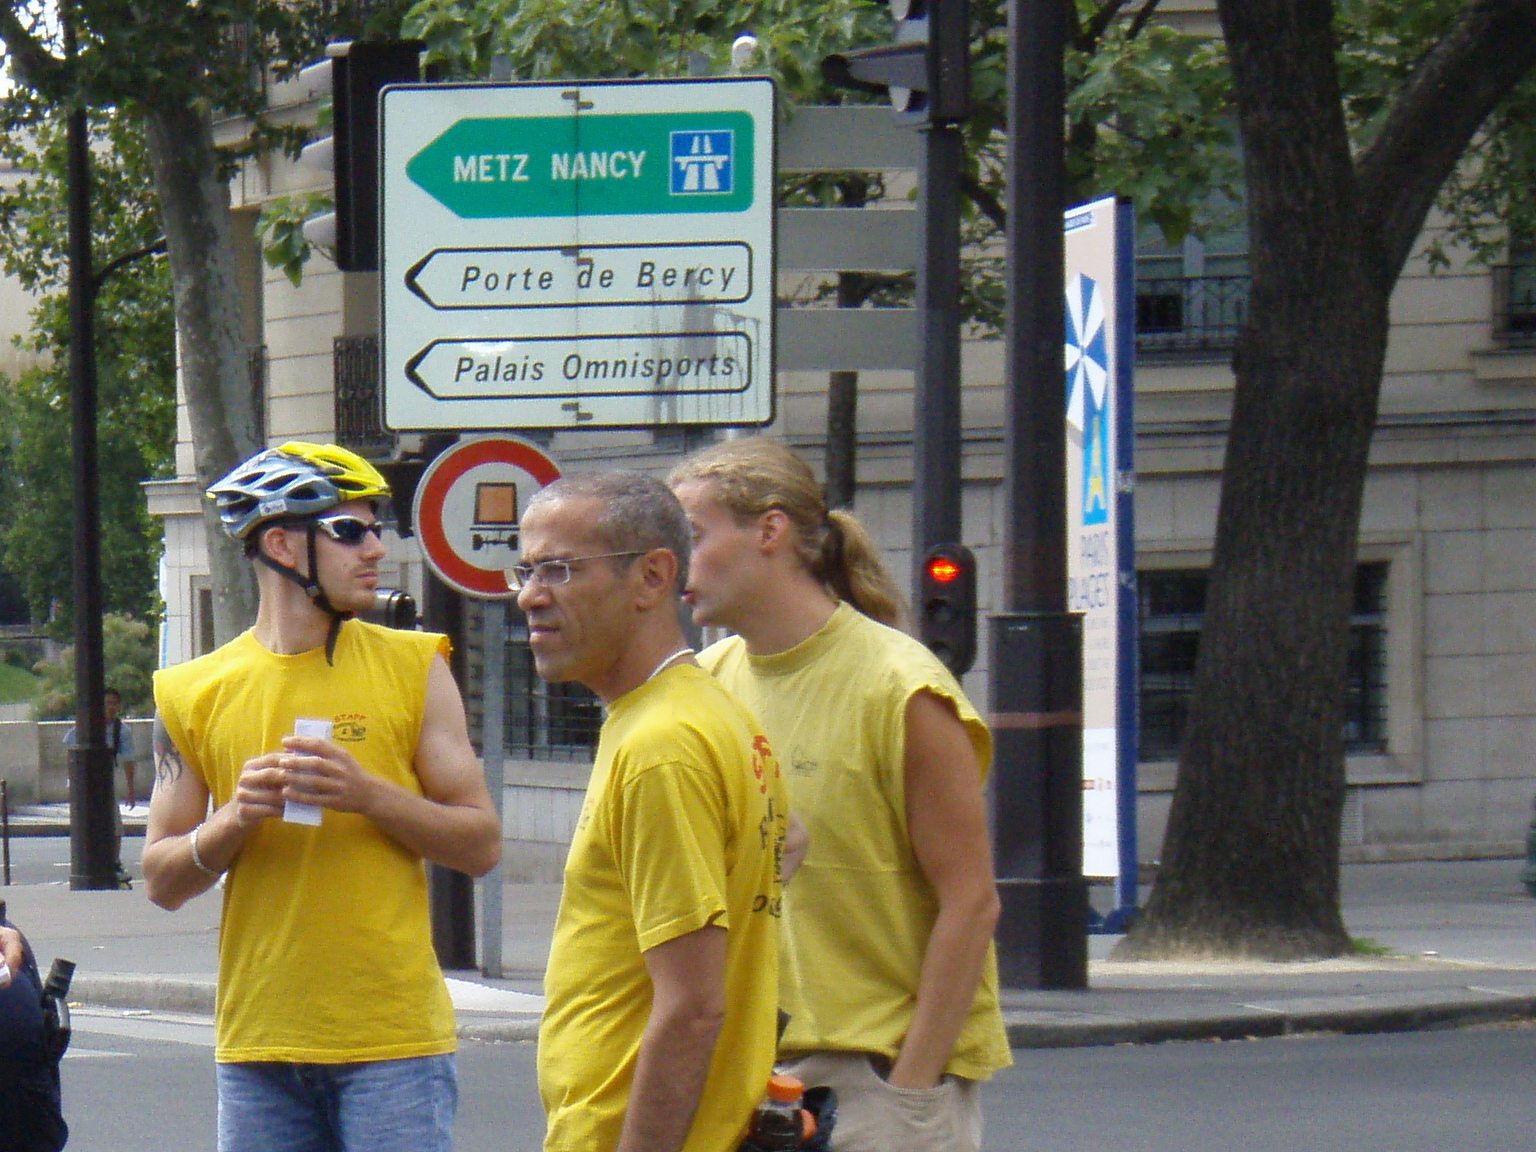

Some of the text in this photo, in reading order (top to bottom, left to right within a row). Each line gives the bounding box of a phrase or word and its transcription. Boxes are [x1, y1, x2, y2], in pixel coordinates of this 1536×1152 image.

[453, 150, 647, 183] METZ NANCY
[460, 260, 736, 292] Porte de Bercy
[454, 350, 736, 387] Palais Omnisports
